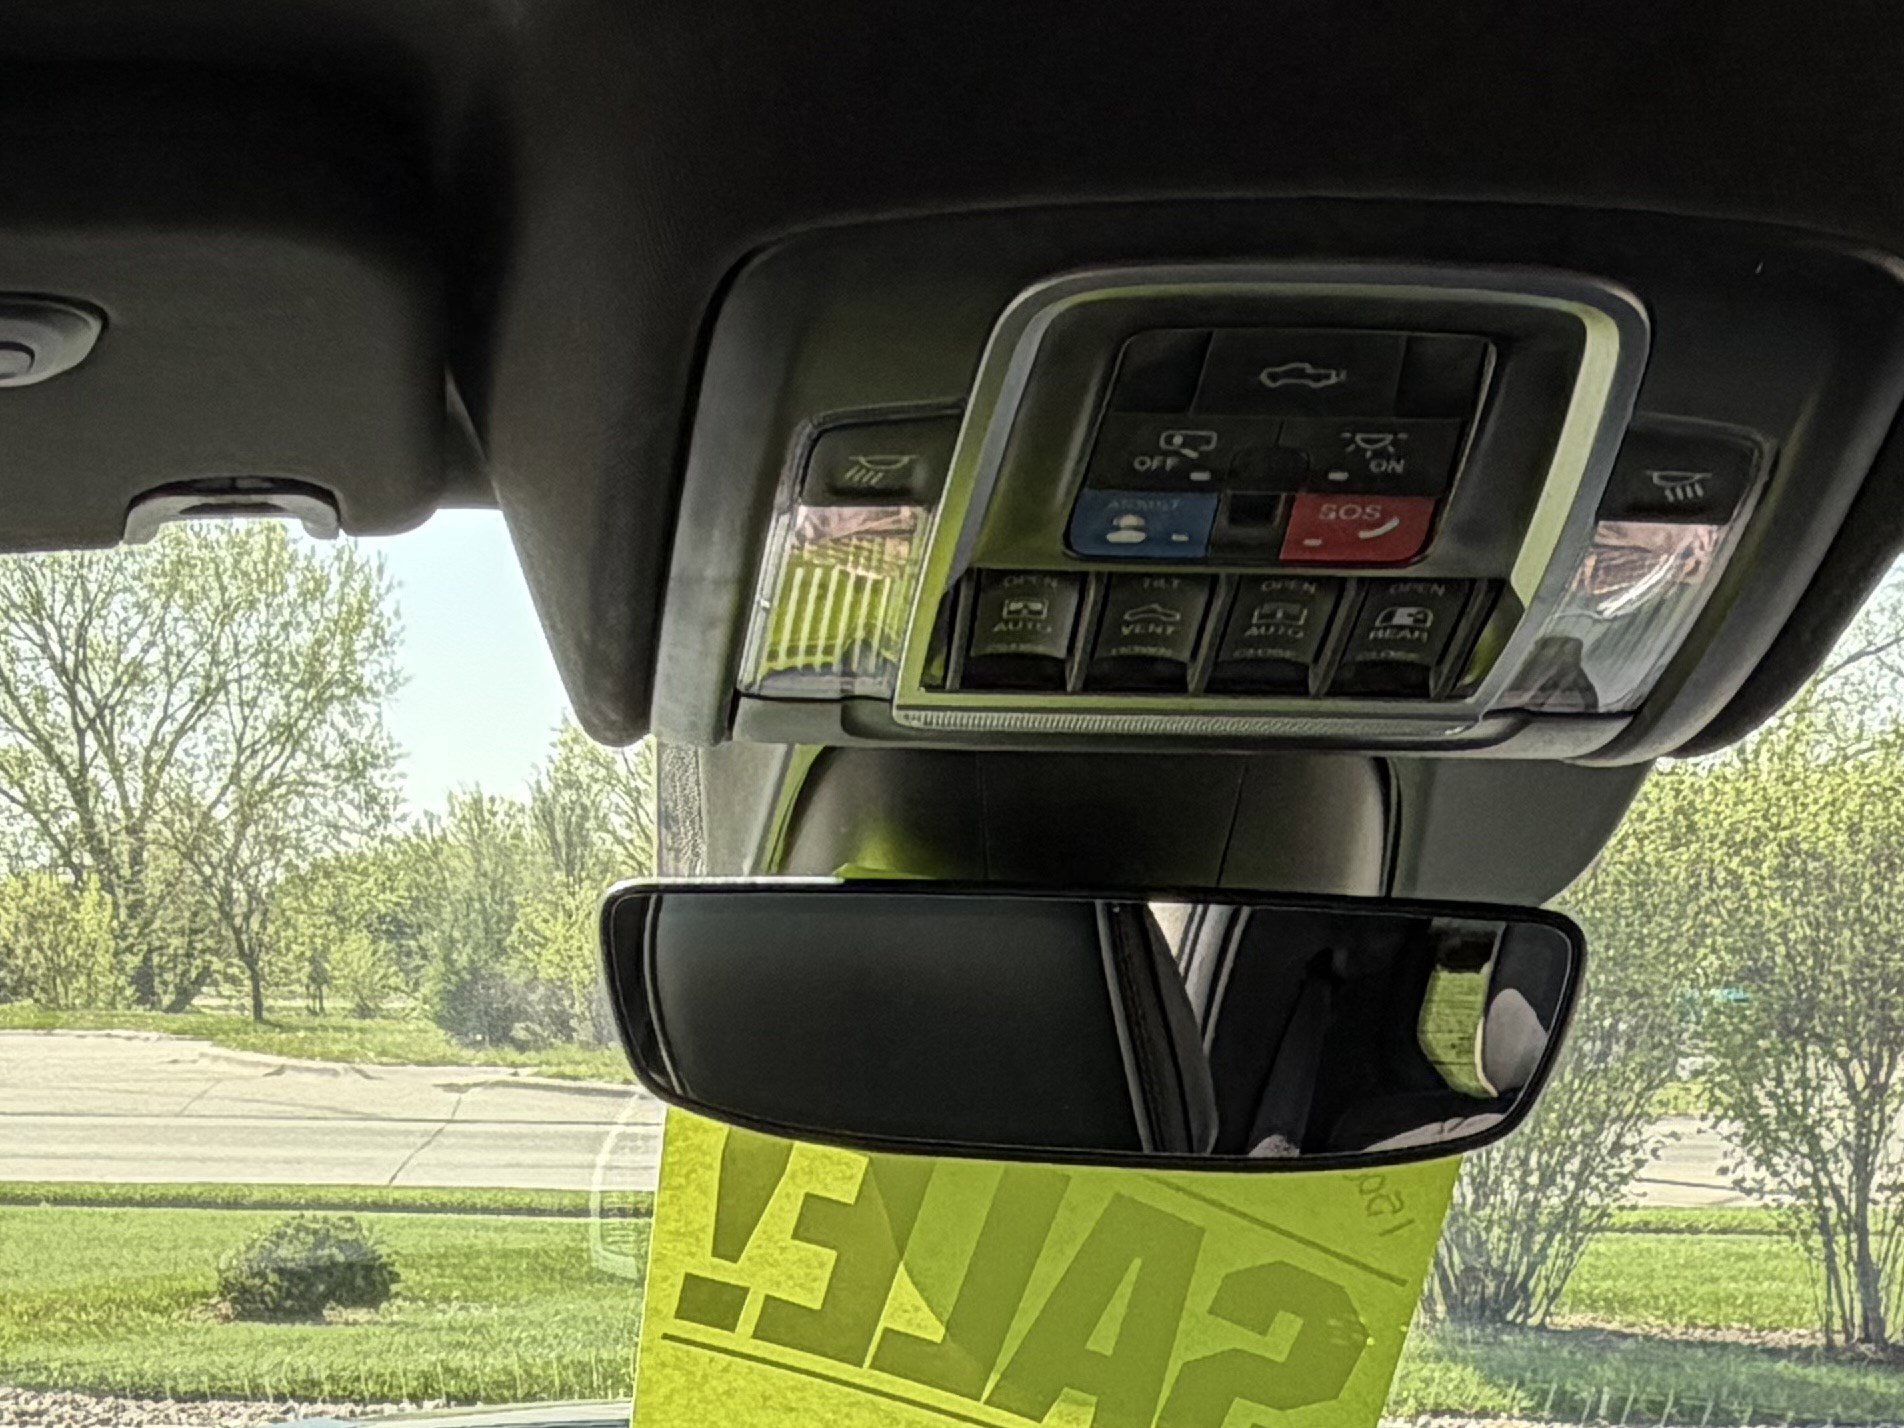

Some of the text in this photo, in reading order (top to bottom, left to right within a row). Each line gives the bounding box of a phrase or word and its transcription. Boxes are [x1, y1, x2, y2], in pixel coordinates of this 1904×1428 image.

[1134, 456, 1179, 472] OFF
[1369, 459, 1405, 473] ON
[1319, 503, 1383, 521] SOS
[993, 621, 1052, 635] AUTO
[1121, 624, 1176, 636] VENT
[1244, 626, 1304, 639] AUTO
